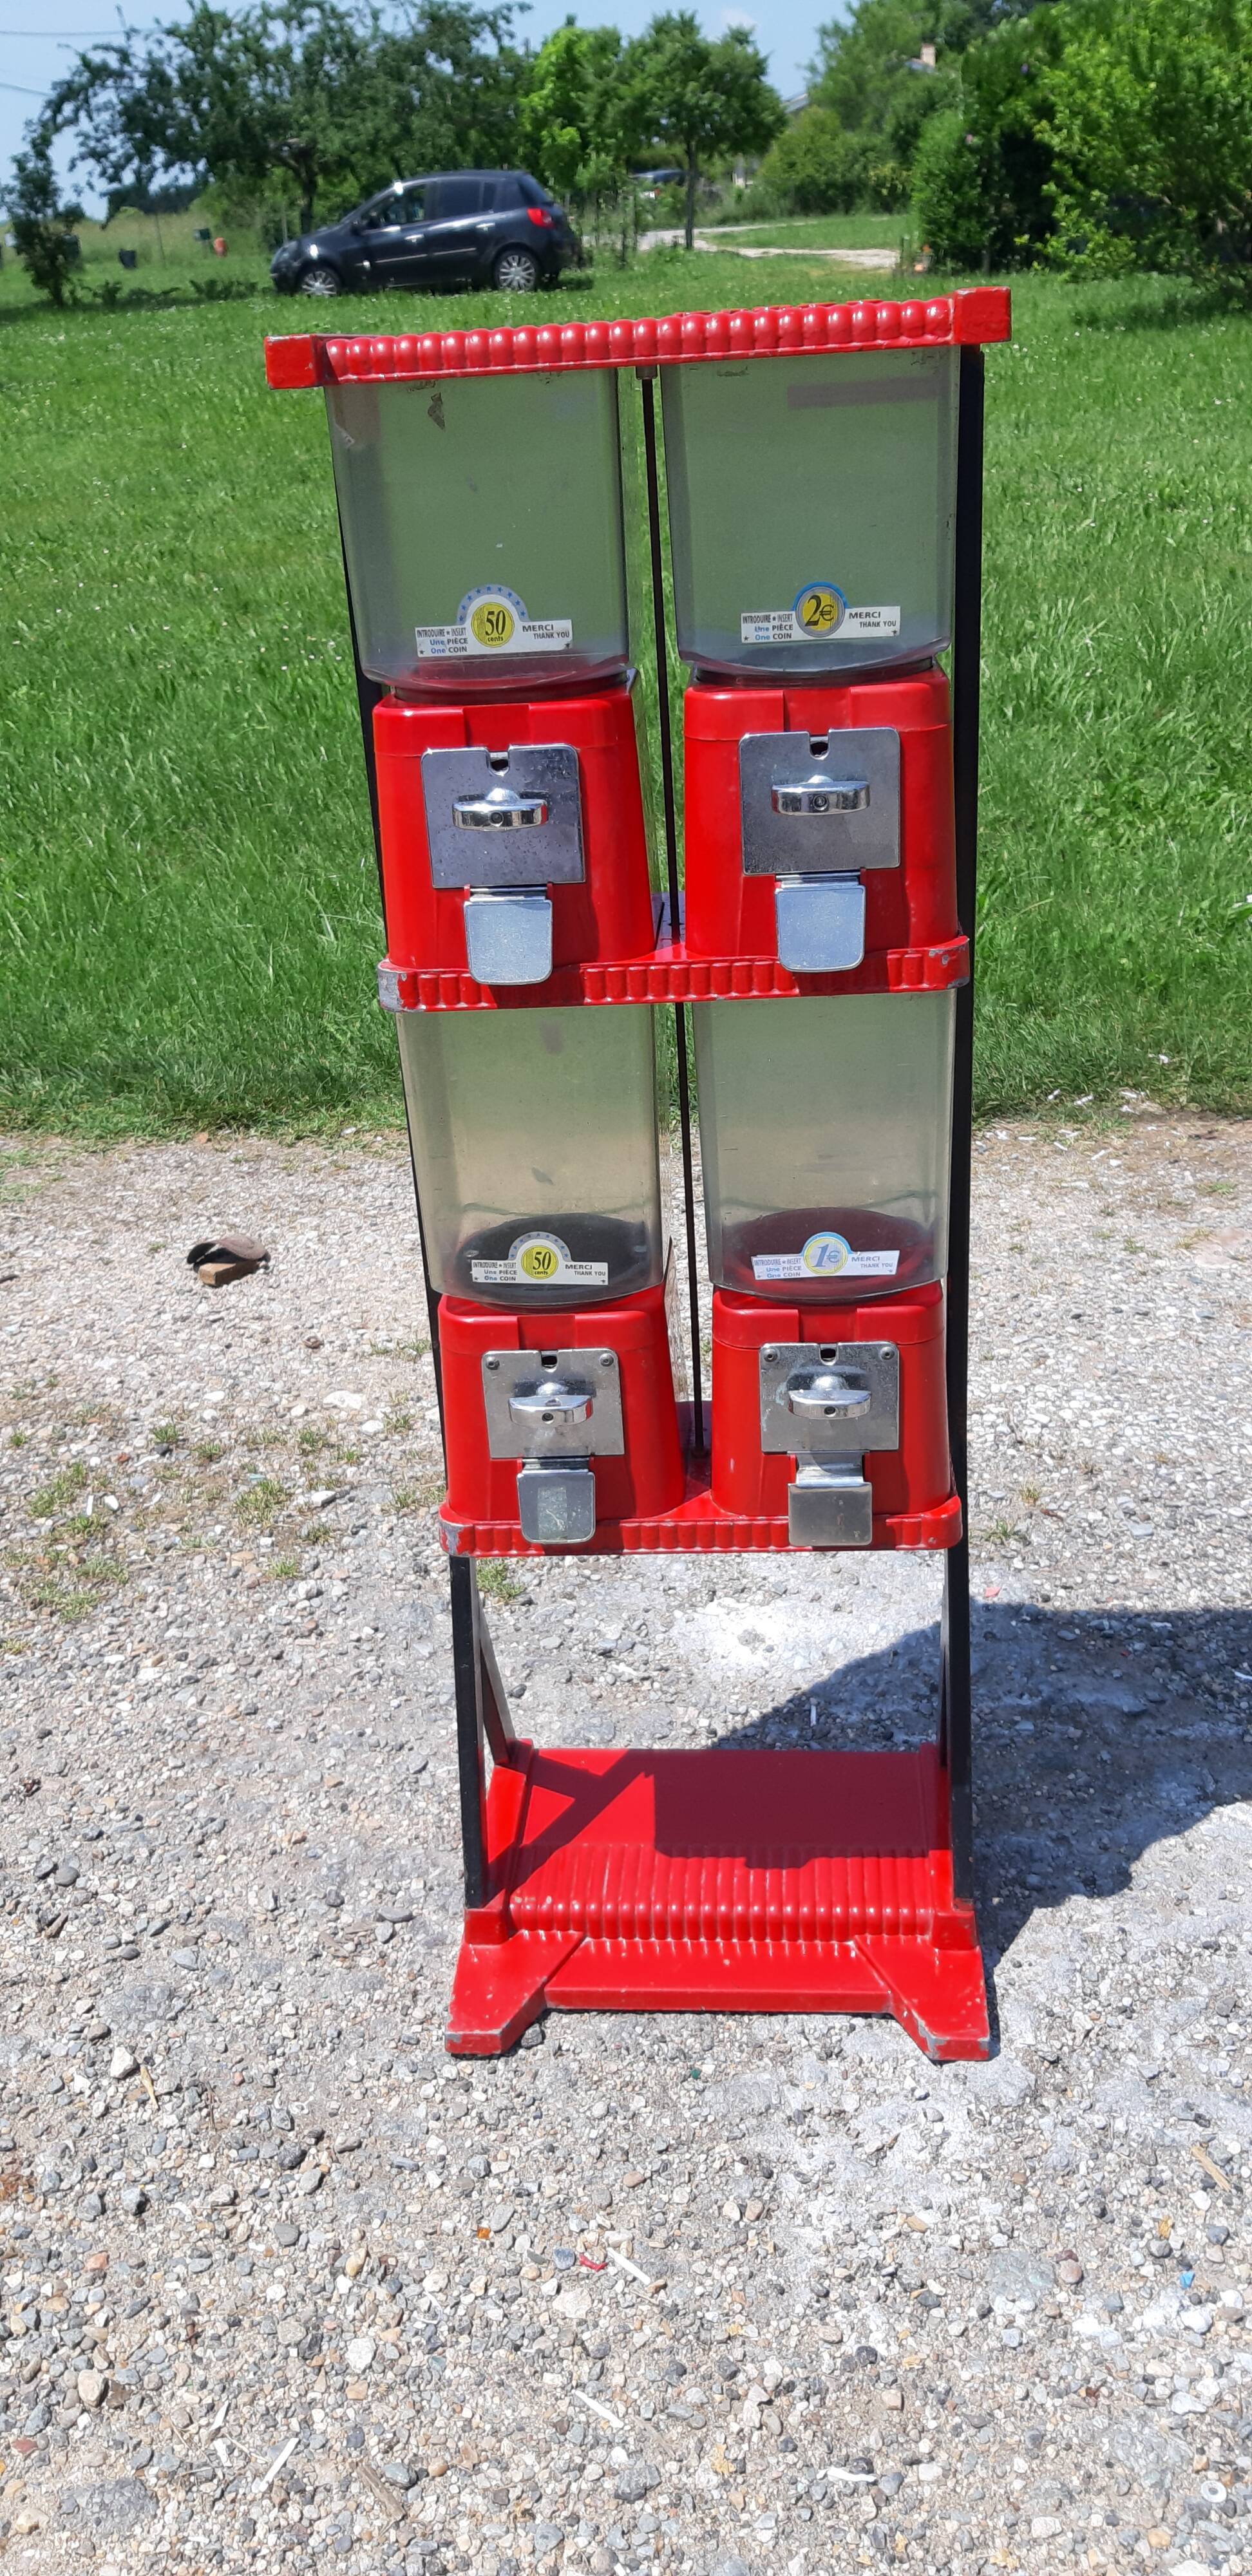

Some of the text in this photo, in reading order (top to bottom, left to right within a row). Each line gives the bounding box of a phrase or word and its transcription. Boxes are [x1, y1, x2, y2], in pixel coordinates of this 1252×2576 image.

[743, 613, 793, 624] INTRODUIRE INSERT
[849, 611, 881, 620] MERCI
[485, 610, 506, 636] 50
[522, 624, 554, 632] MERCI
[417, 627, 466, 638] INTRODUIRE INSERT
[446, 636, 468, 645] PIÈCE
[533, 1251, 551, 1271] 50
[754, 1258, 781, 1266] INTRODUIRE
